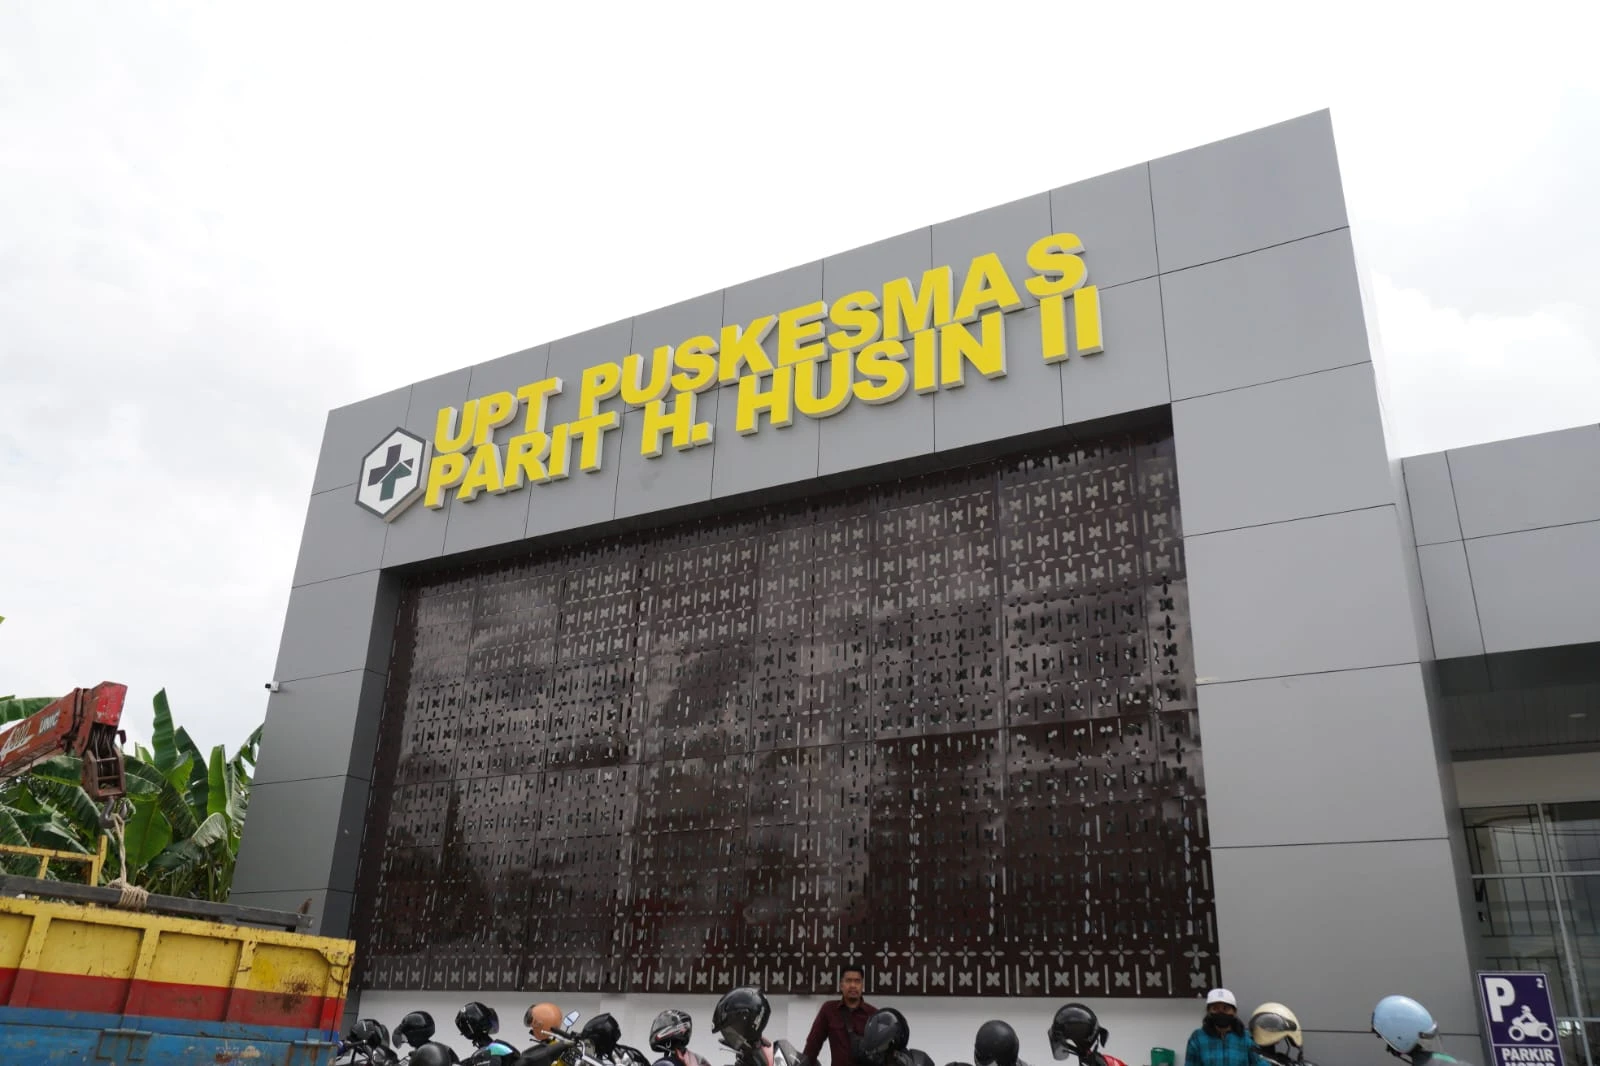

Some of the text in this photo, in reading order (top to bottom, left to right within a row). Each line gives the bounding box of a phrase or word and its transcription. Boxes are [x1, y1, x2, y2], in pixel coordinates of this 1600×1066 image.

[424, 284, 1104, 510] PARIT H. HUSIN II
[434, 232, 1088, 454] UPT PUSKESMAS
[1484, 977, 1545, 1022] P 2
[1501, 1047, 1555, 1062] PARKIR
